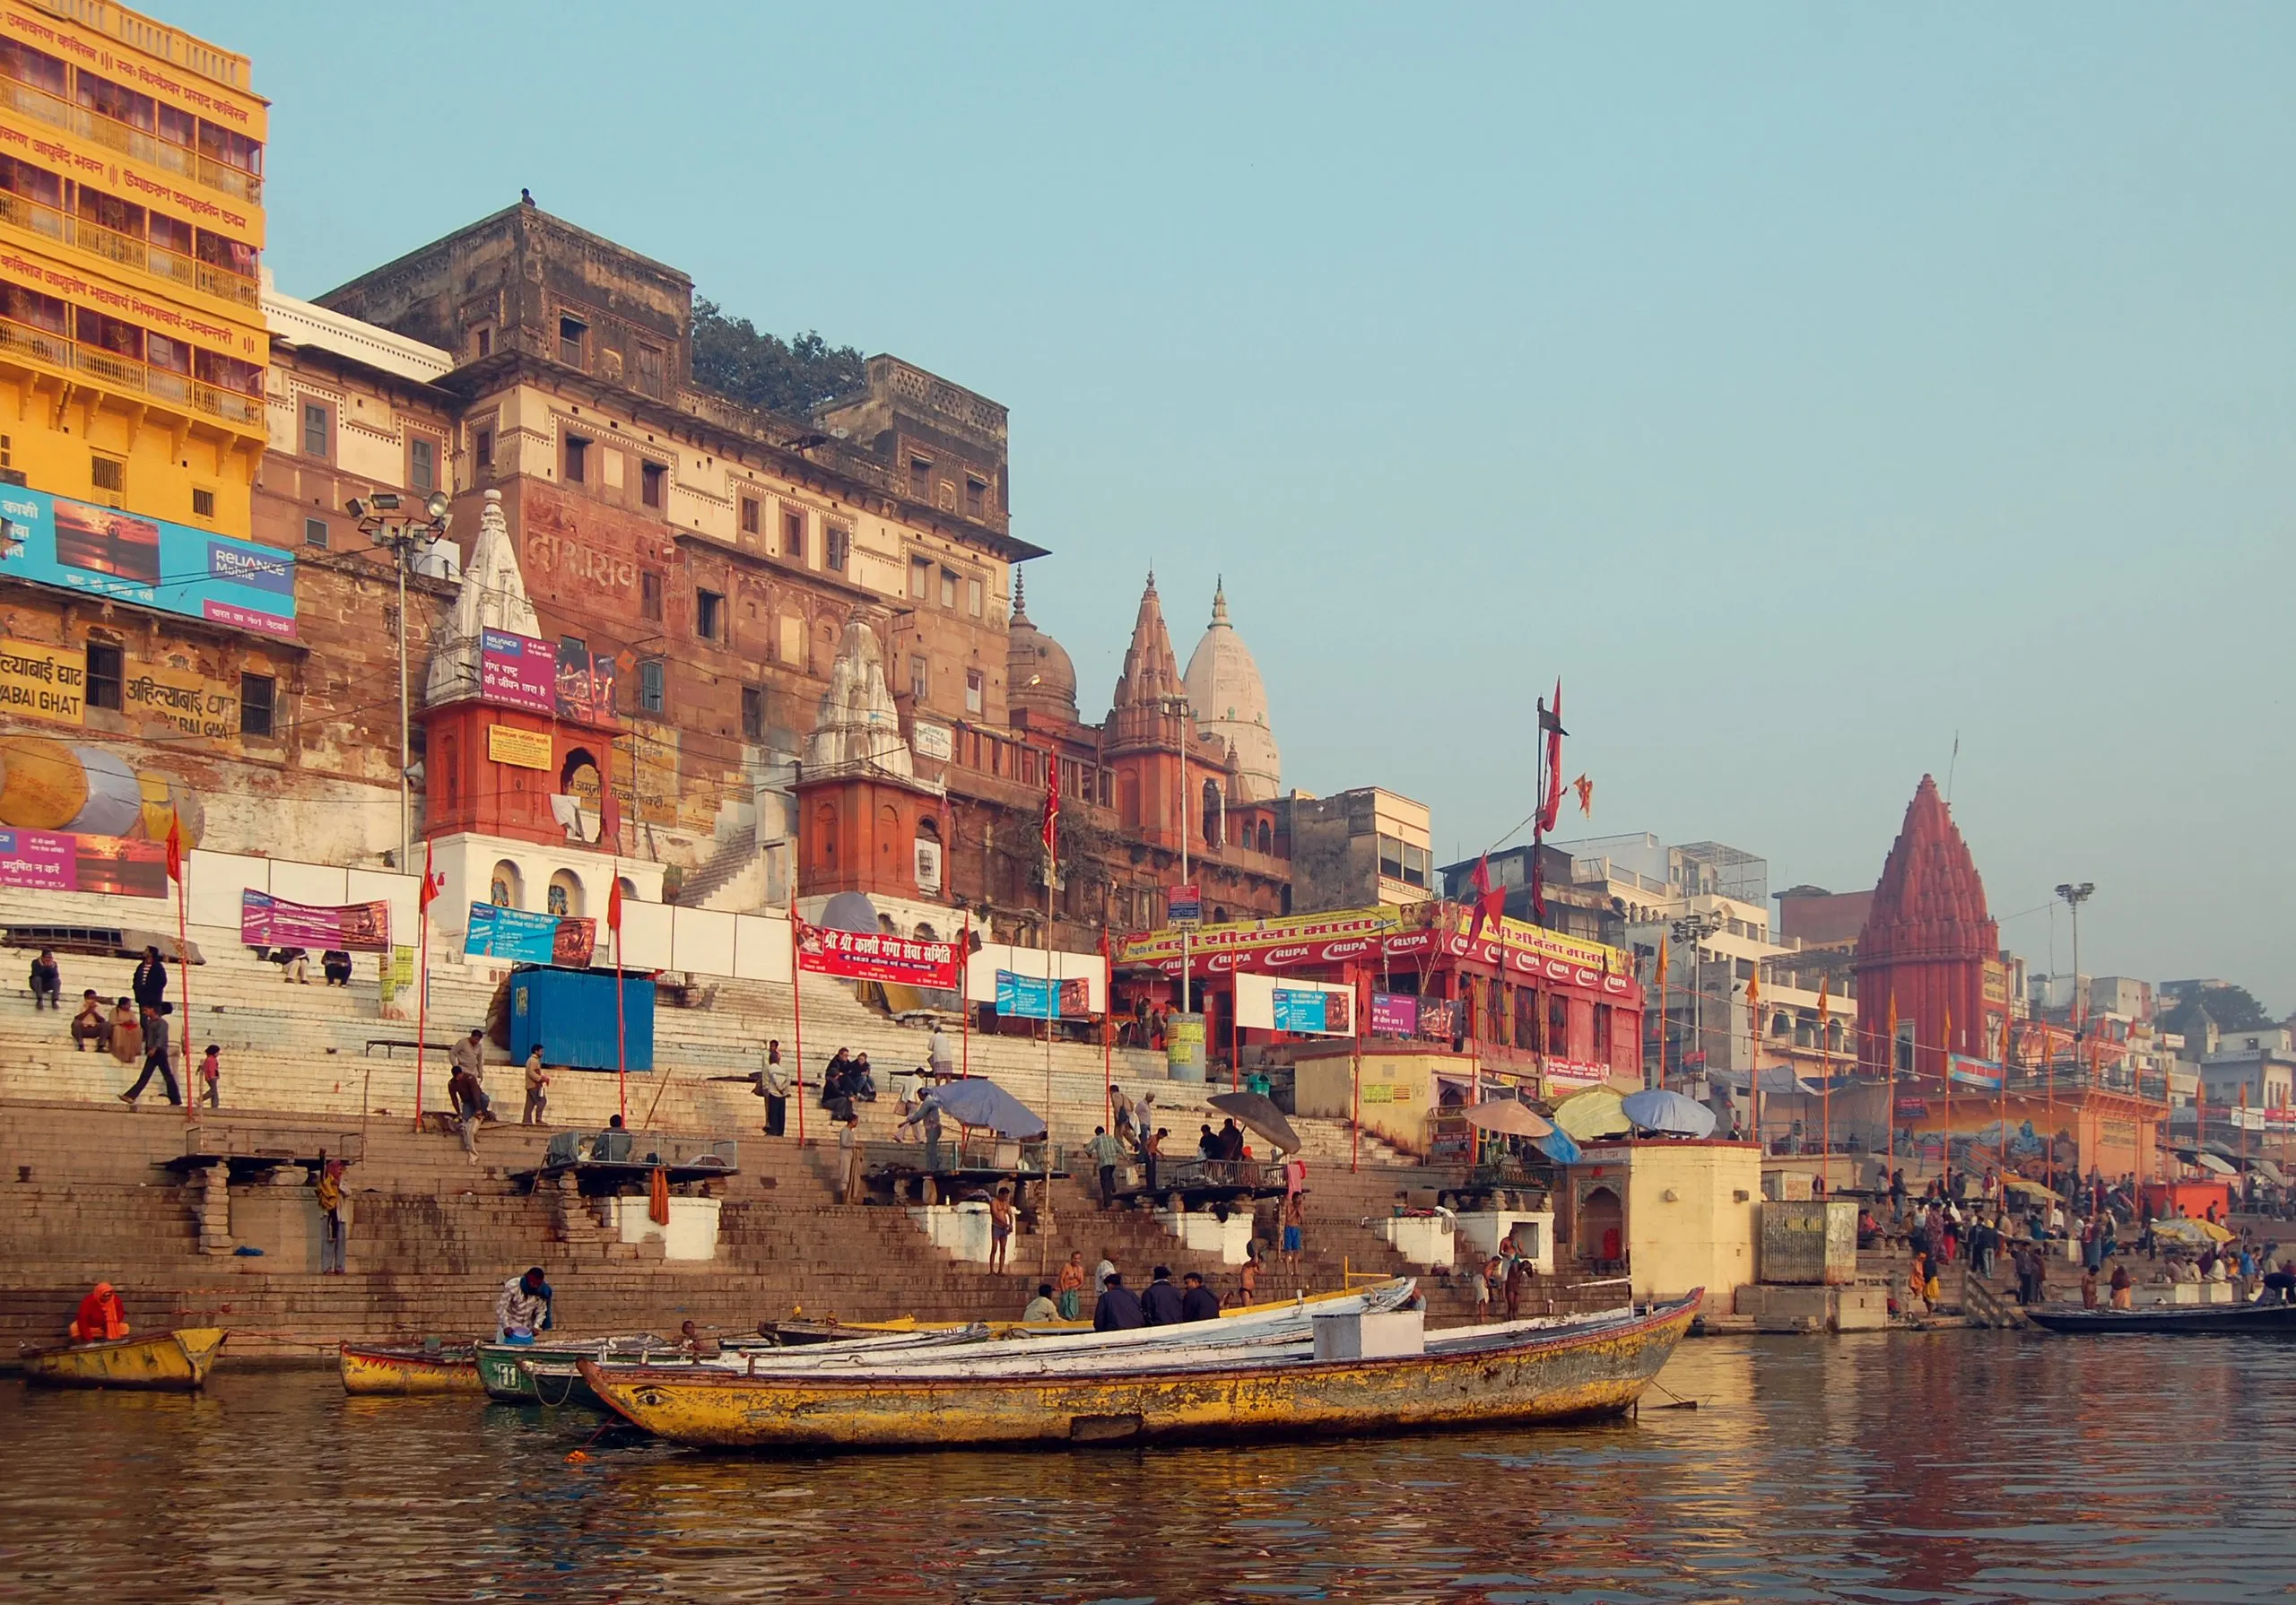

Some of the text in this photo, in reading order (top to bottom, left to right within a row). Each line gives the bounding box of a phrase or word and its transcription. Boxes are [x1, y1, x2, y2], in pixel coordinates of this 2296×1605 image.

[32, 139, 72, 168] आयुर्वेद
[74, 154, 104, 176] भवन
[216, 560, 255, 581] Mobile
[0, 653, 83, 686] ल्याबाई घाट
[39, 691, 81, 716] GHAT
[126, 675, 204, 717] अहिल्याबाई
[825, 931, 951, 964] श्री श्री काशी गंगा सेवा समिति
[1166, 959, 1196, 970] RUA
[1275, 946, 1309, 959] RUPA
[1333, 941, 1368, 953] RUPA
[1393, 935, 1429, 948] RUPA
[500, 1366, 517, 1386] 11
